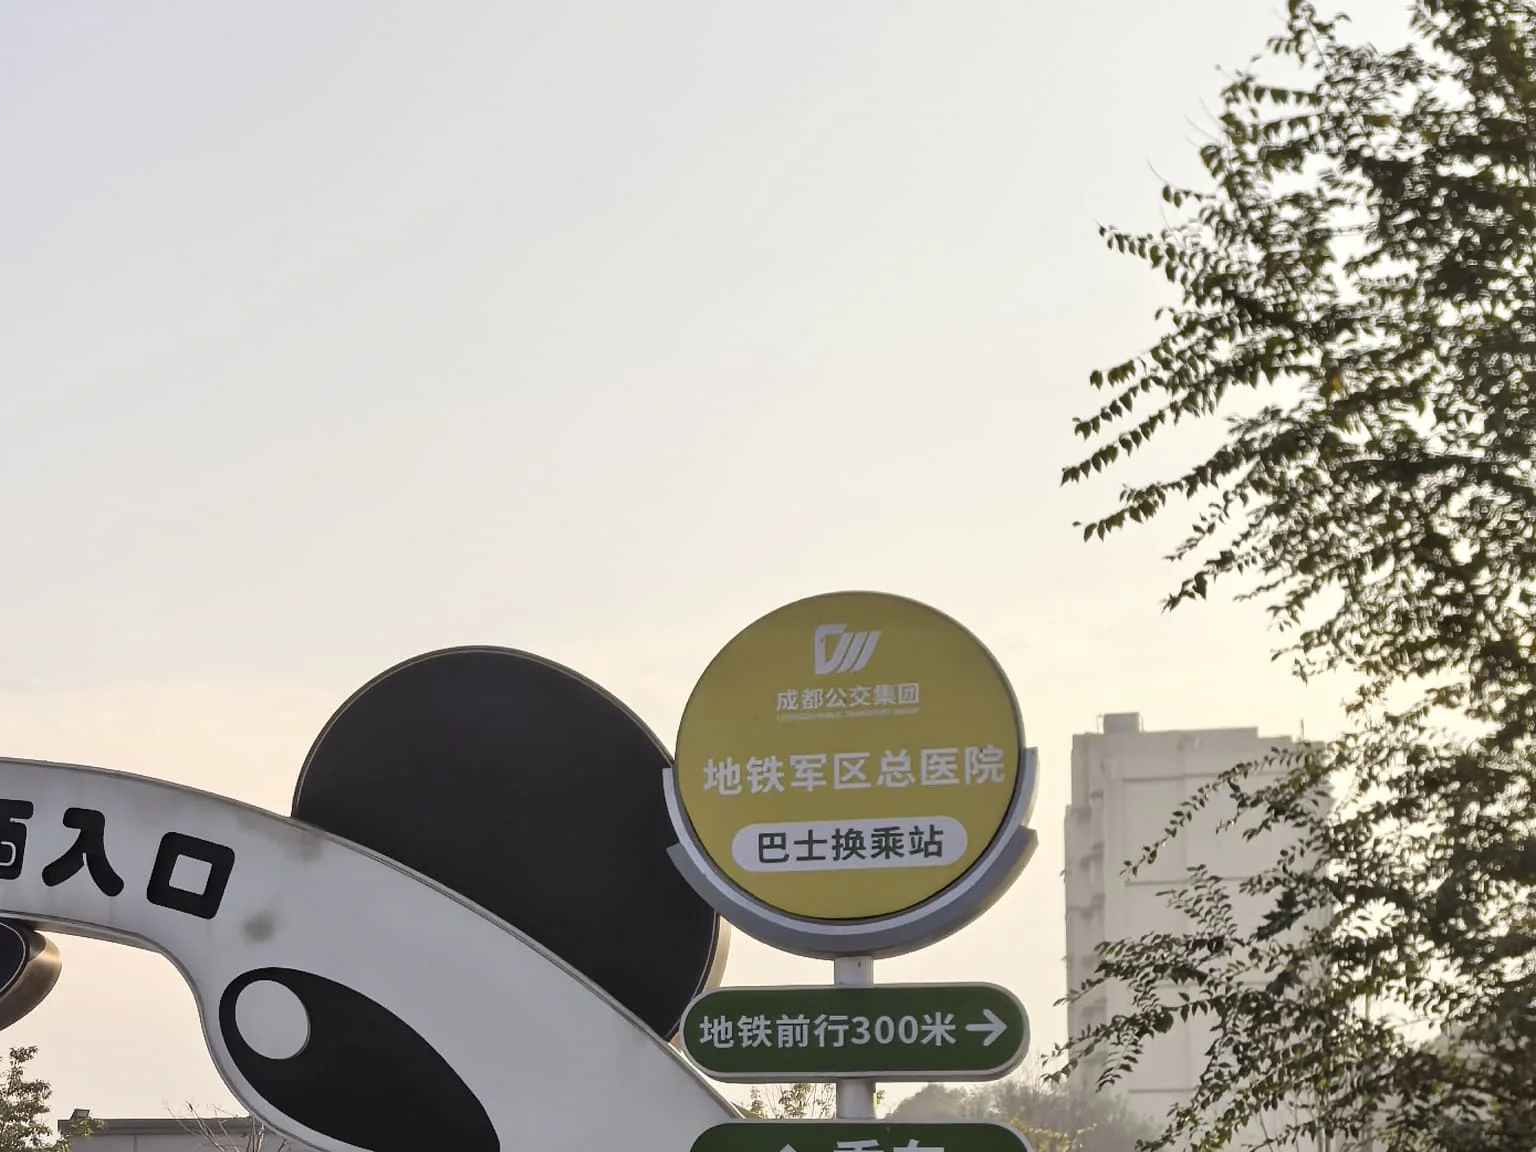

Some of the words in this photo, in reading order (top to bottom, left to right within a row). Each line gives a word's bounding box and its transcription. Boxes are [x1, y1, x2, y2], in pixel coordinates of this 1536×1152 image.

[776, 683, 920, 711] 成都公交集团
[702, 745, 1005, 796] 地铁军区总医院
[757, 824, 944, 863] 巴士换乘站
[699, 1012, 957, 1049] 地铁前行300米
